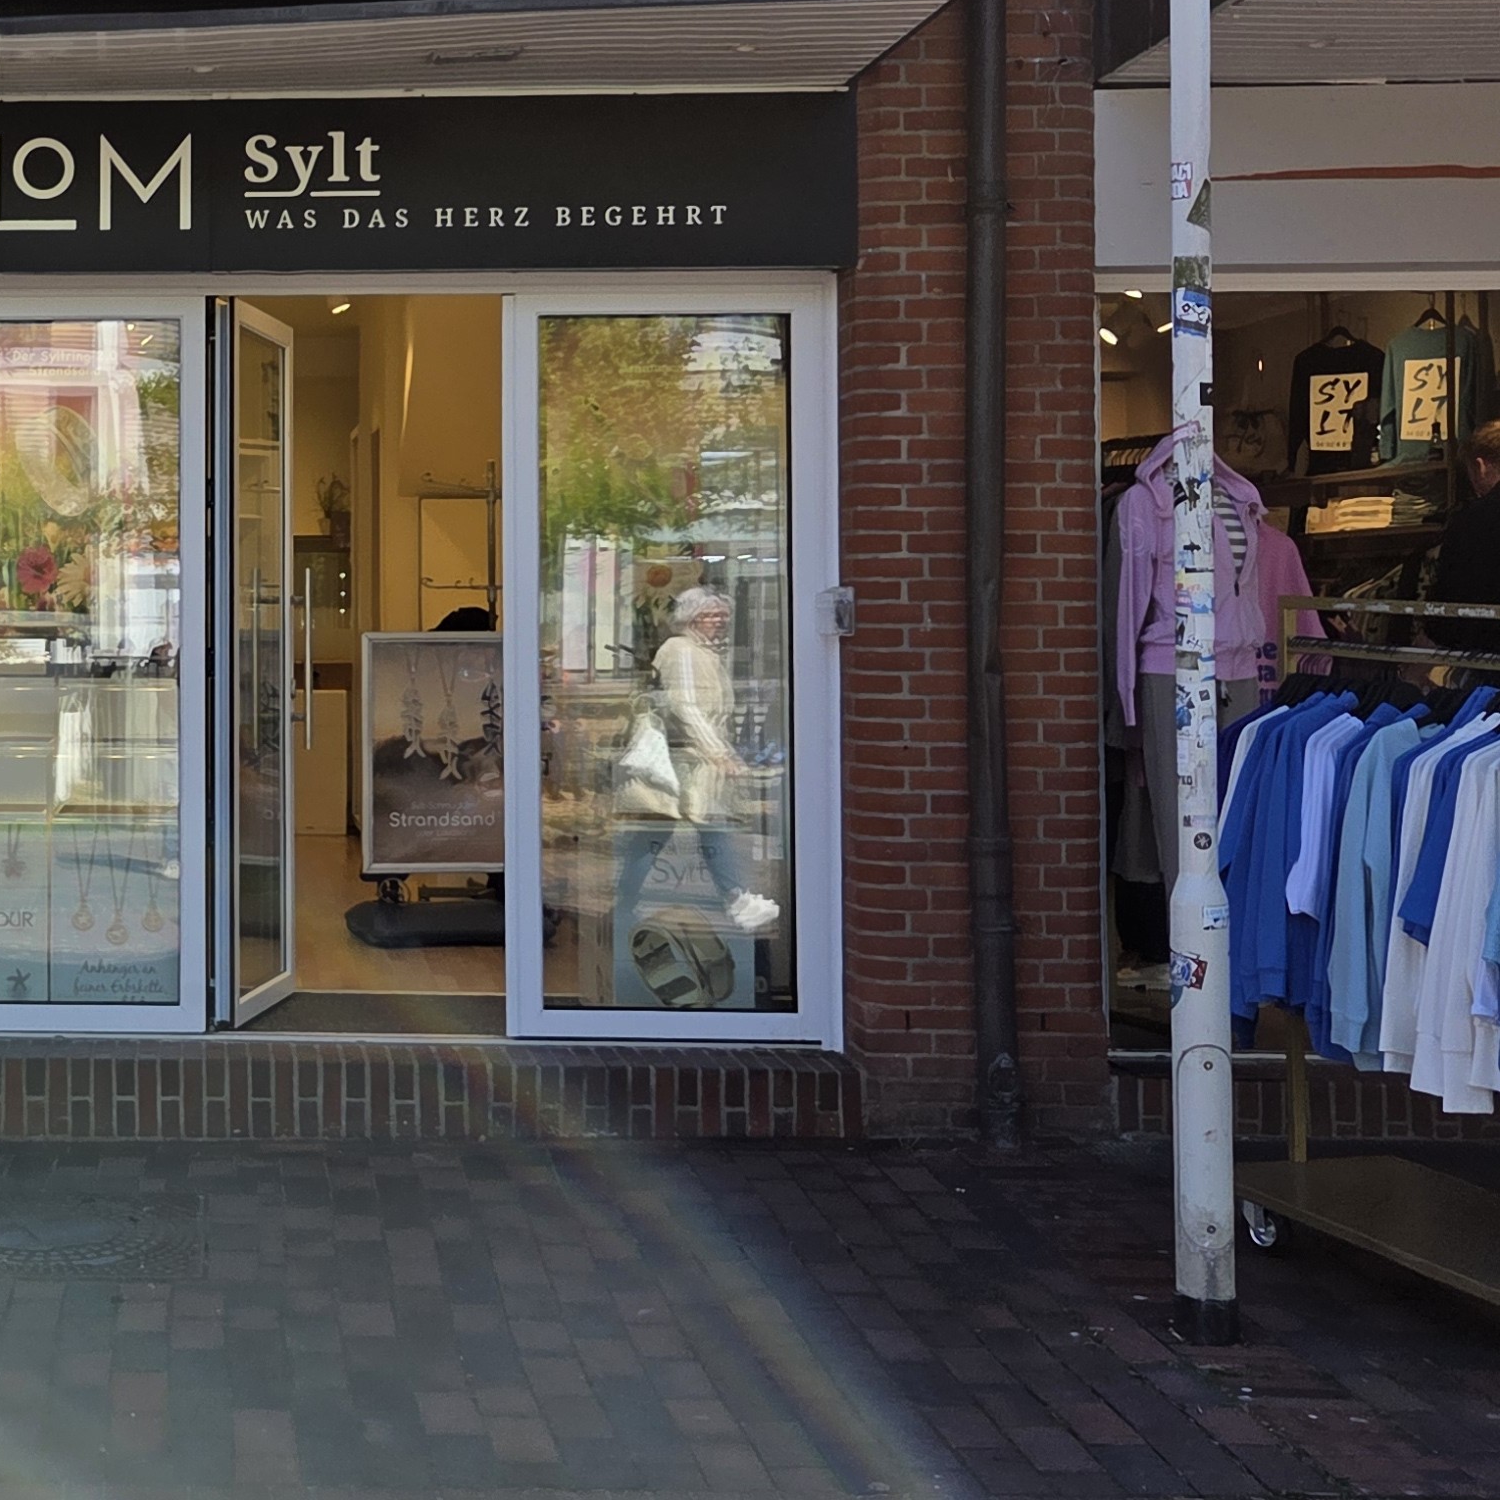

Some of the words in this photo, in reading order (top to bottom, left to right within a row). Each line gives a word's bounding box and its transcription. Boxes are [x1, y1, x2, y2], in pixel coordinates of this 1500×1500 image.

[244, 131, 381, 198] Sylt
[244, 208, 318, 229] WAS
[342, 208, 410, 228] DAS
[434, 206, 531, 228] HERZ
[555, 205, 729, 227] BEGEHRT
[388, 811, 496, 828] Strandsand
